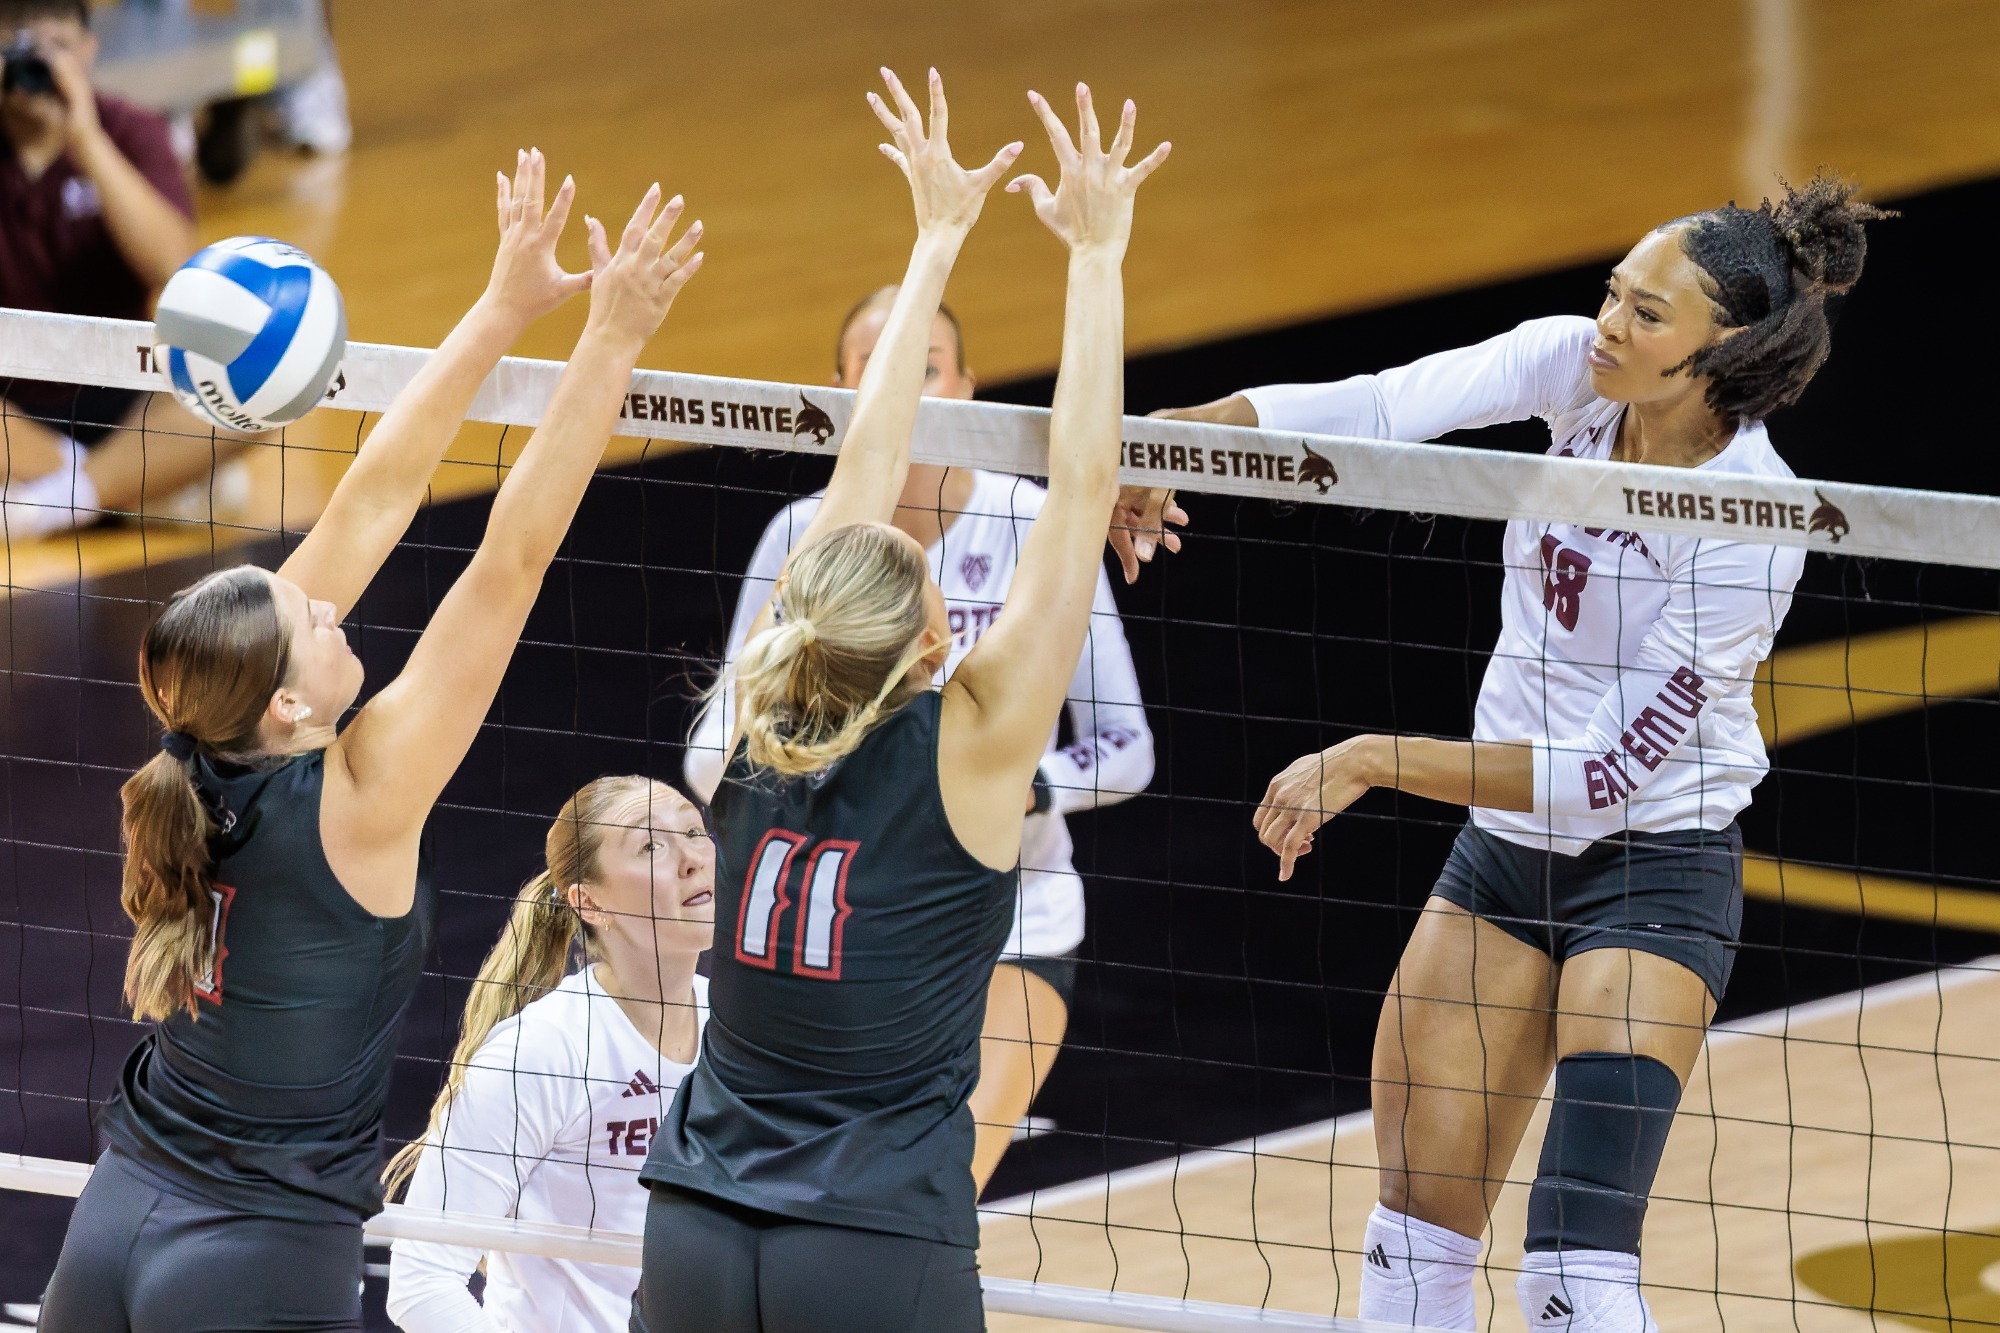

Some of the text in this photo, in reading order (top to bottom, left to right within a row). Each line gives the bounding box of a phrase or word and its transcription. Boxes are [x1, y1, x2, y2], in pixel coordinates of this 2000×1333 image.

[711, 401, 793, 432] STATE
[1211, 450, 1295, 481] STATE
[1623, 487, 1806, 531] TEXAS STATE
[1541, 533, 1592, 632] 18
[1584, 748, 1639, 810] EAT
[1656, 665, 1708, 719] UP
[735, 828, 861, 981] 11
